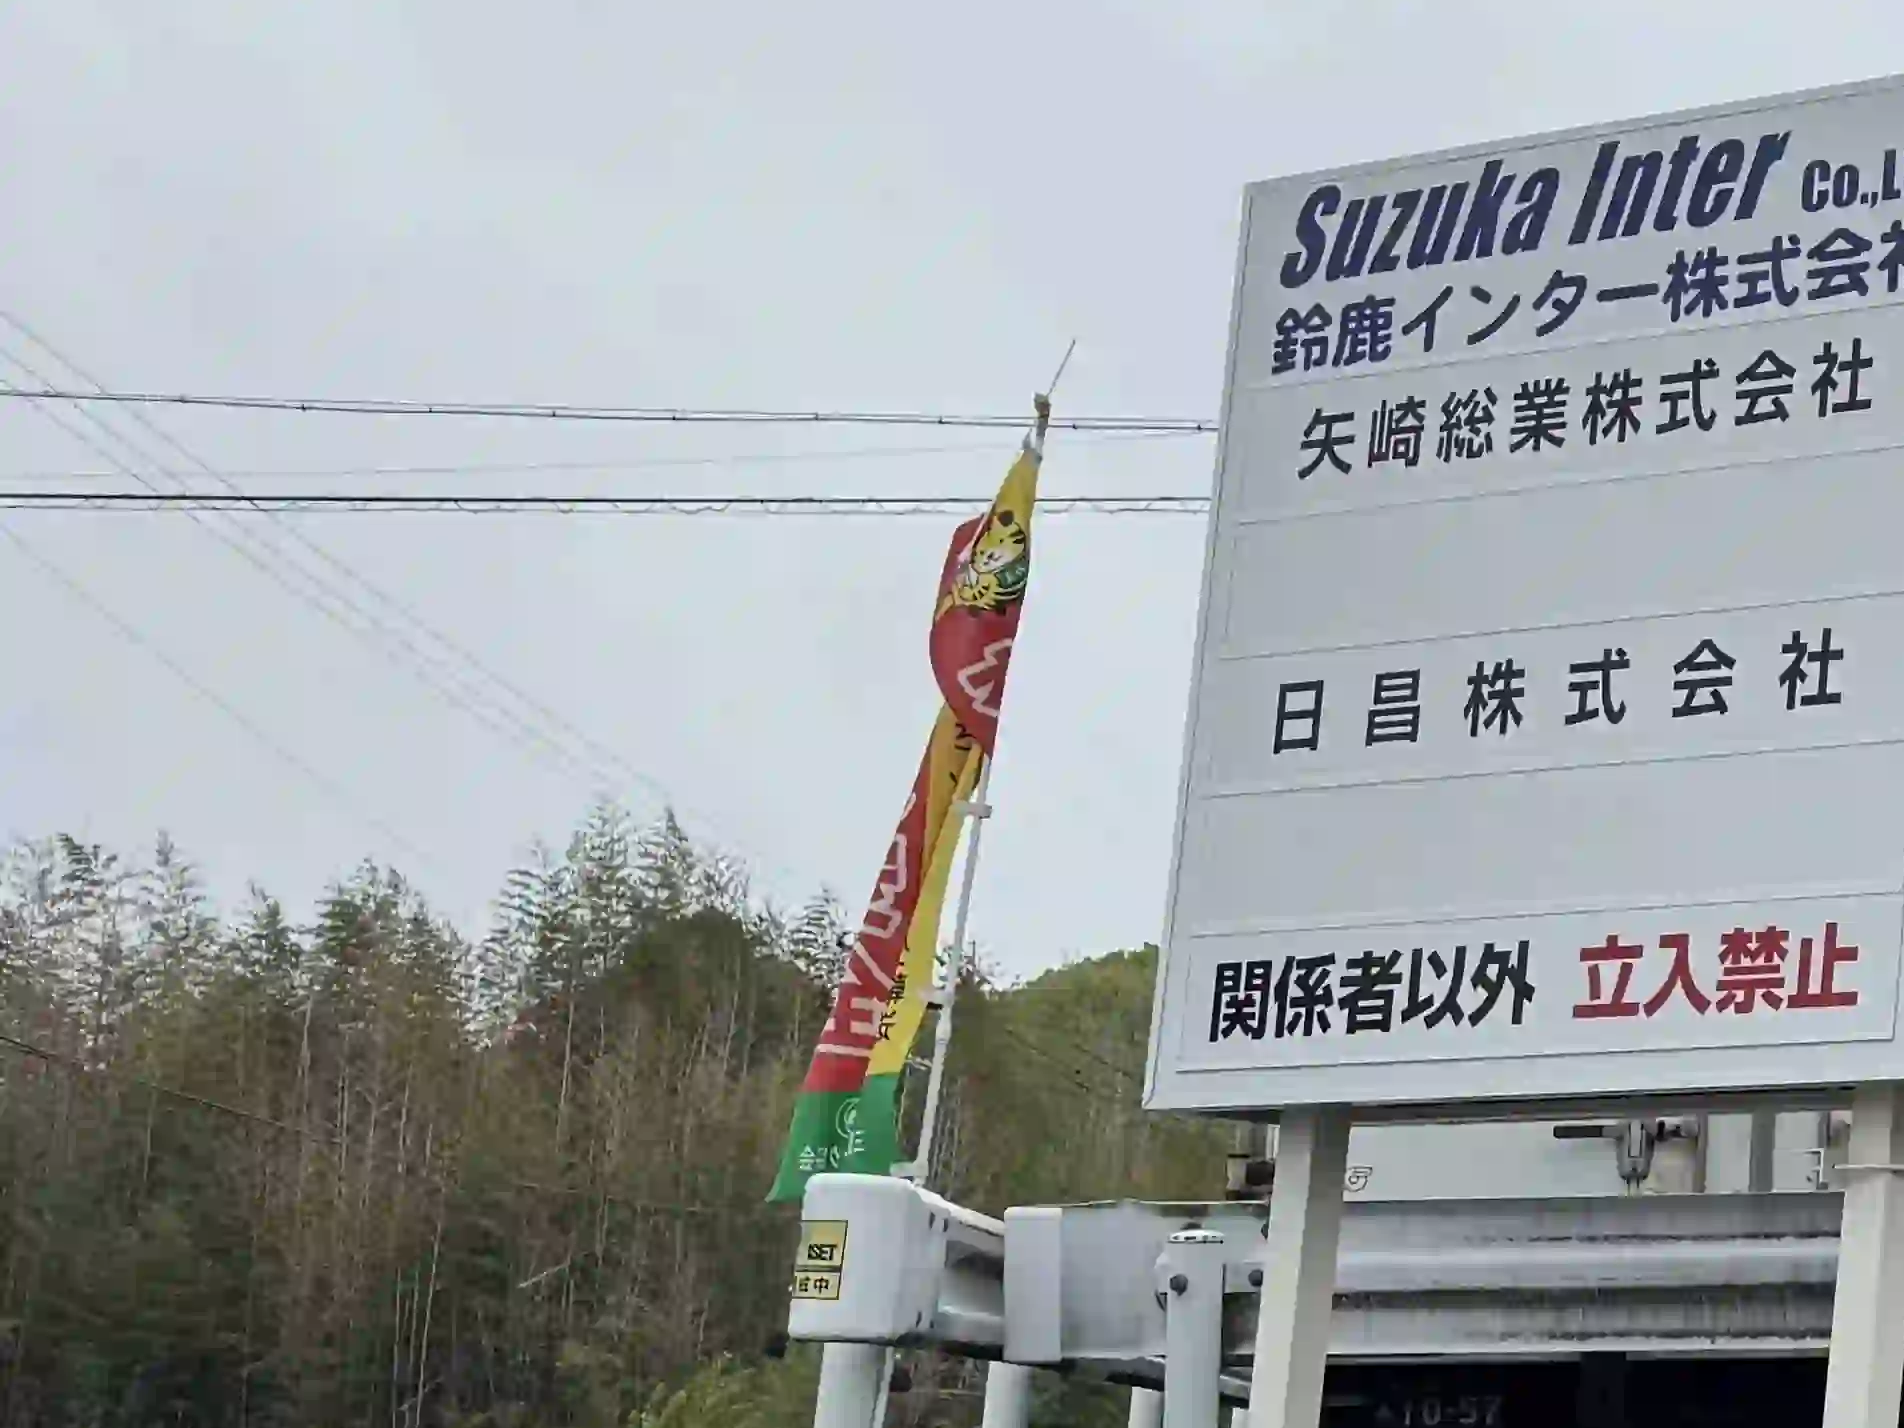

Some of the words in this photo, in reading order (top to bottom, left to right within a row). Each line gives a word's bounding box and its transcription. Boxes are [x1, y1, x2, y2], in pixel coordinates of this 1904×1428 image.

[1280, 162, 1559, 288] Suzuka
[1568, 131, 1791, 245] Inter
[1298, 338, 1873, 479] 矢崎総業株式会社
[1273, 628, 1843, 754] 日昌株式会社
[1209, 940, 1535, 1042] 関係者以外
[1572, 922, 1858, 1020] 立入禁止
